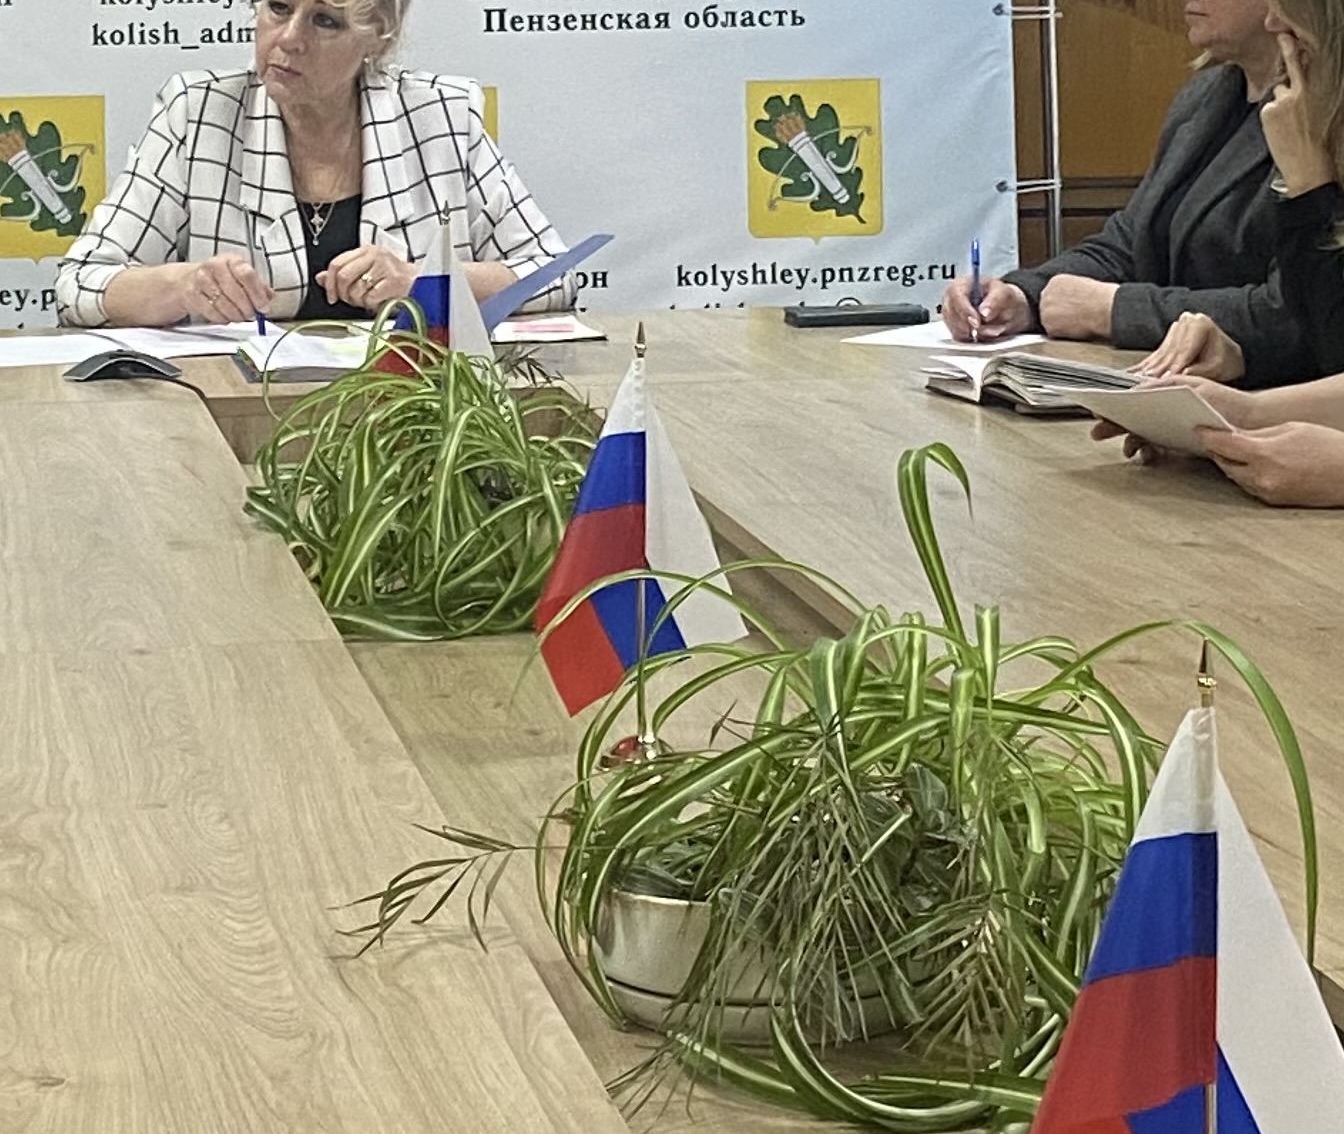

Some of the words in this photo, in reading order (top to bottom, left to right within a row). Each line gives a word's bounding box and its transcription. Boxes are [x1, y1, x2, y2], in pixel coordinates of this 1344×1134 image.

[482, 8, 671, 33] Пензенская
[683, 4, 806, 29] область
[91, 20, 256, 50] kolish_adm
[676, 261, 957, 292] kolyshley.pnzreg.ru
